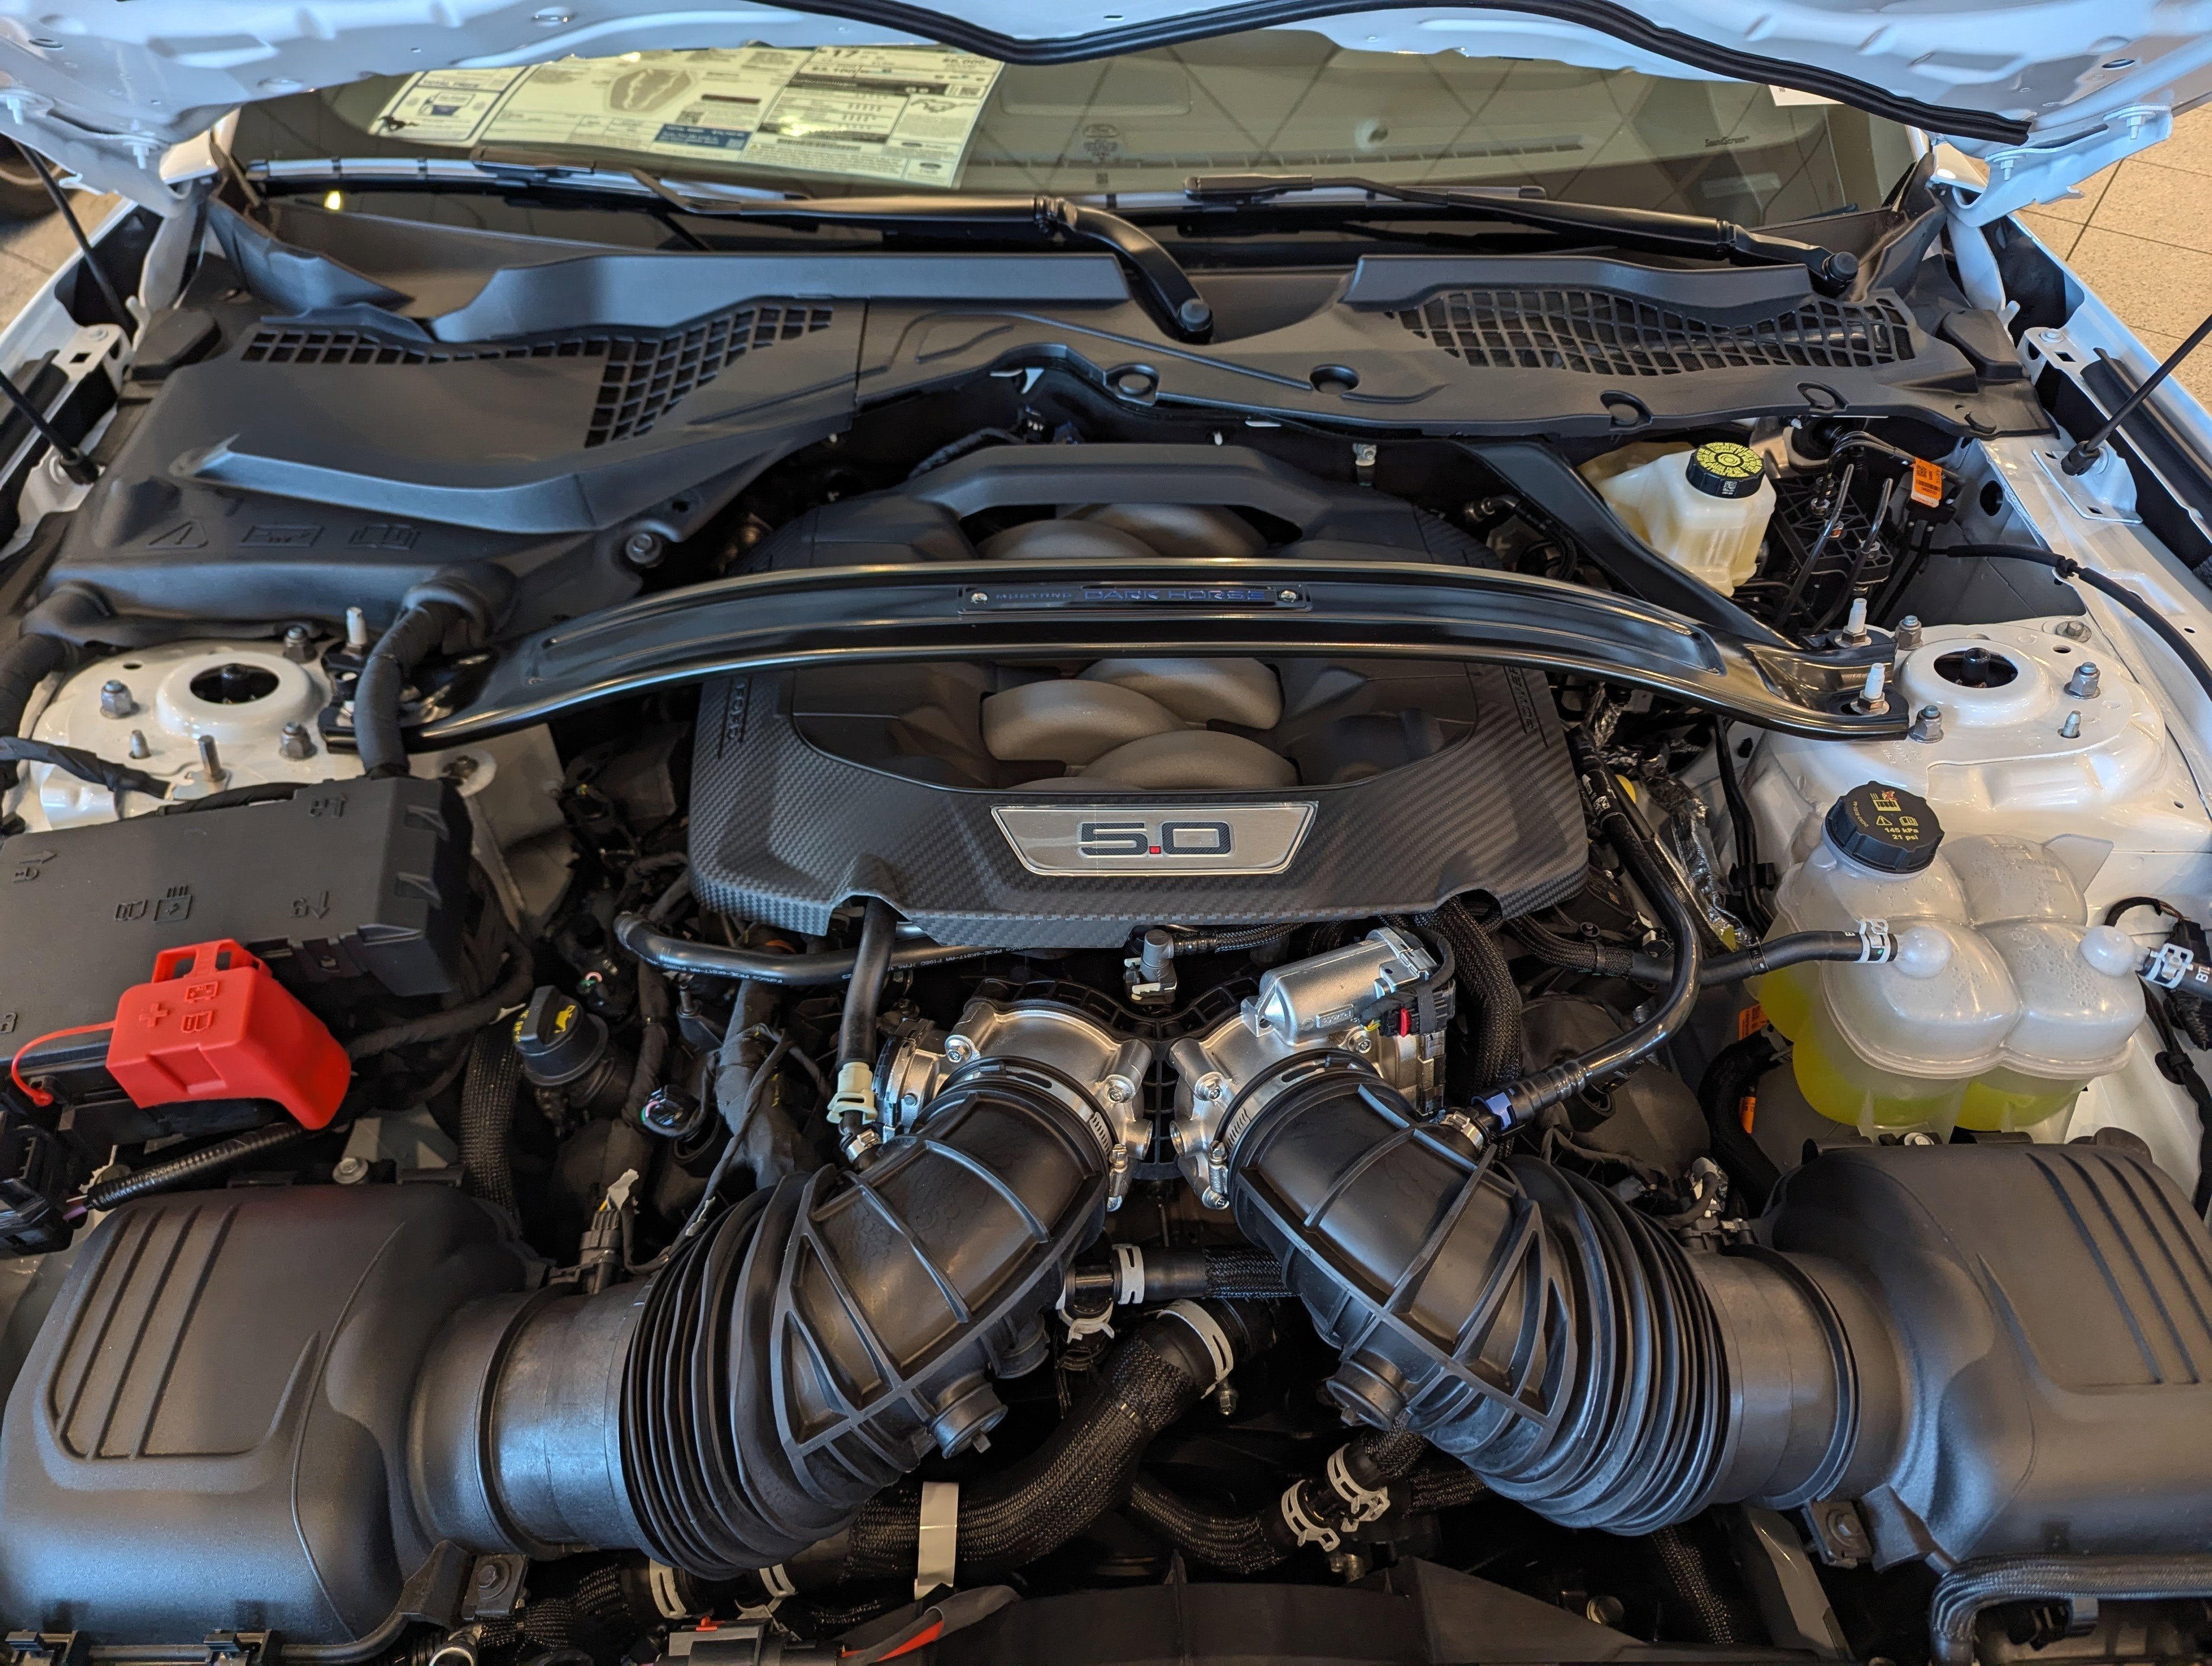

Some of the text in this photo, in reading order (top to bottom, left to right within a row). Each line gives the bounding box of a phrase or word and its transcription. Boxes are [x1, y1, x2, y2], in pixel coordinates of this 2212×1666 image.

[1084, 589, 1160, 600] DARK
[1168, 589, 1265, 600] HORSE
[1078, 821, 1233, 857] 5.0
